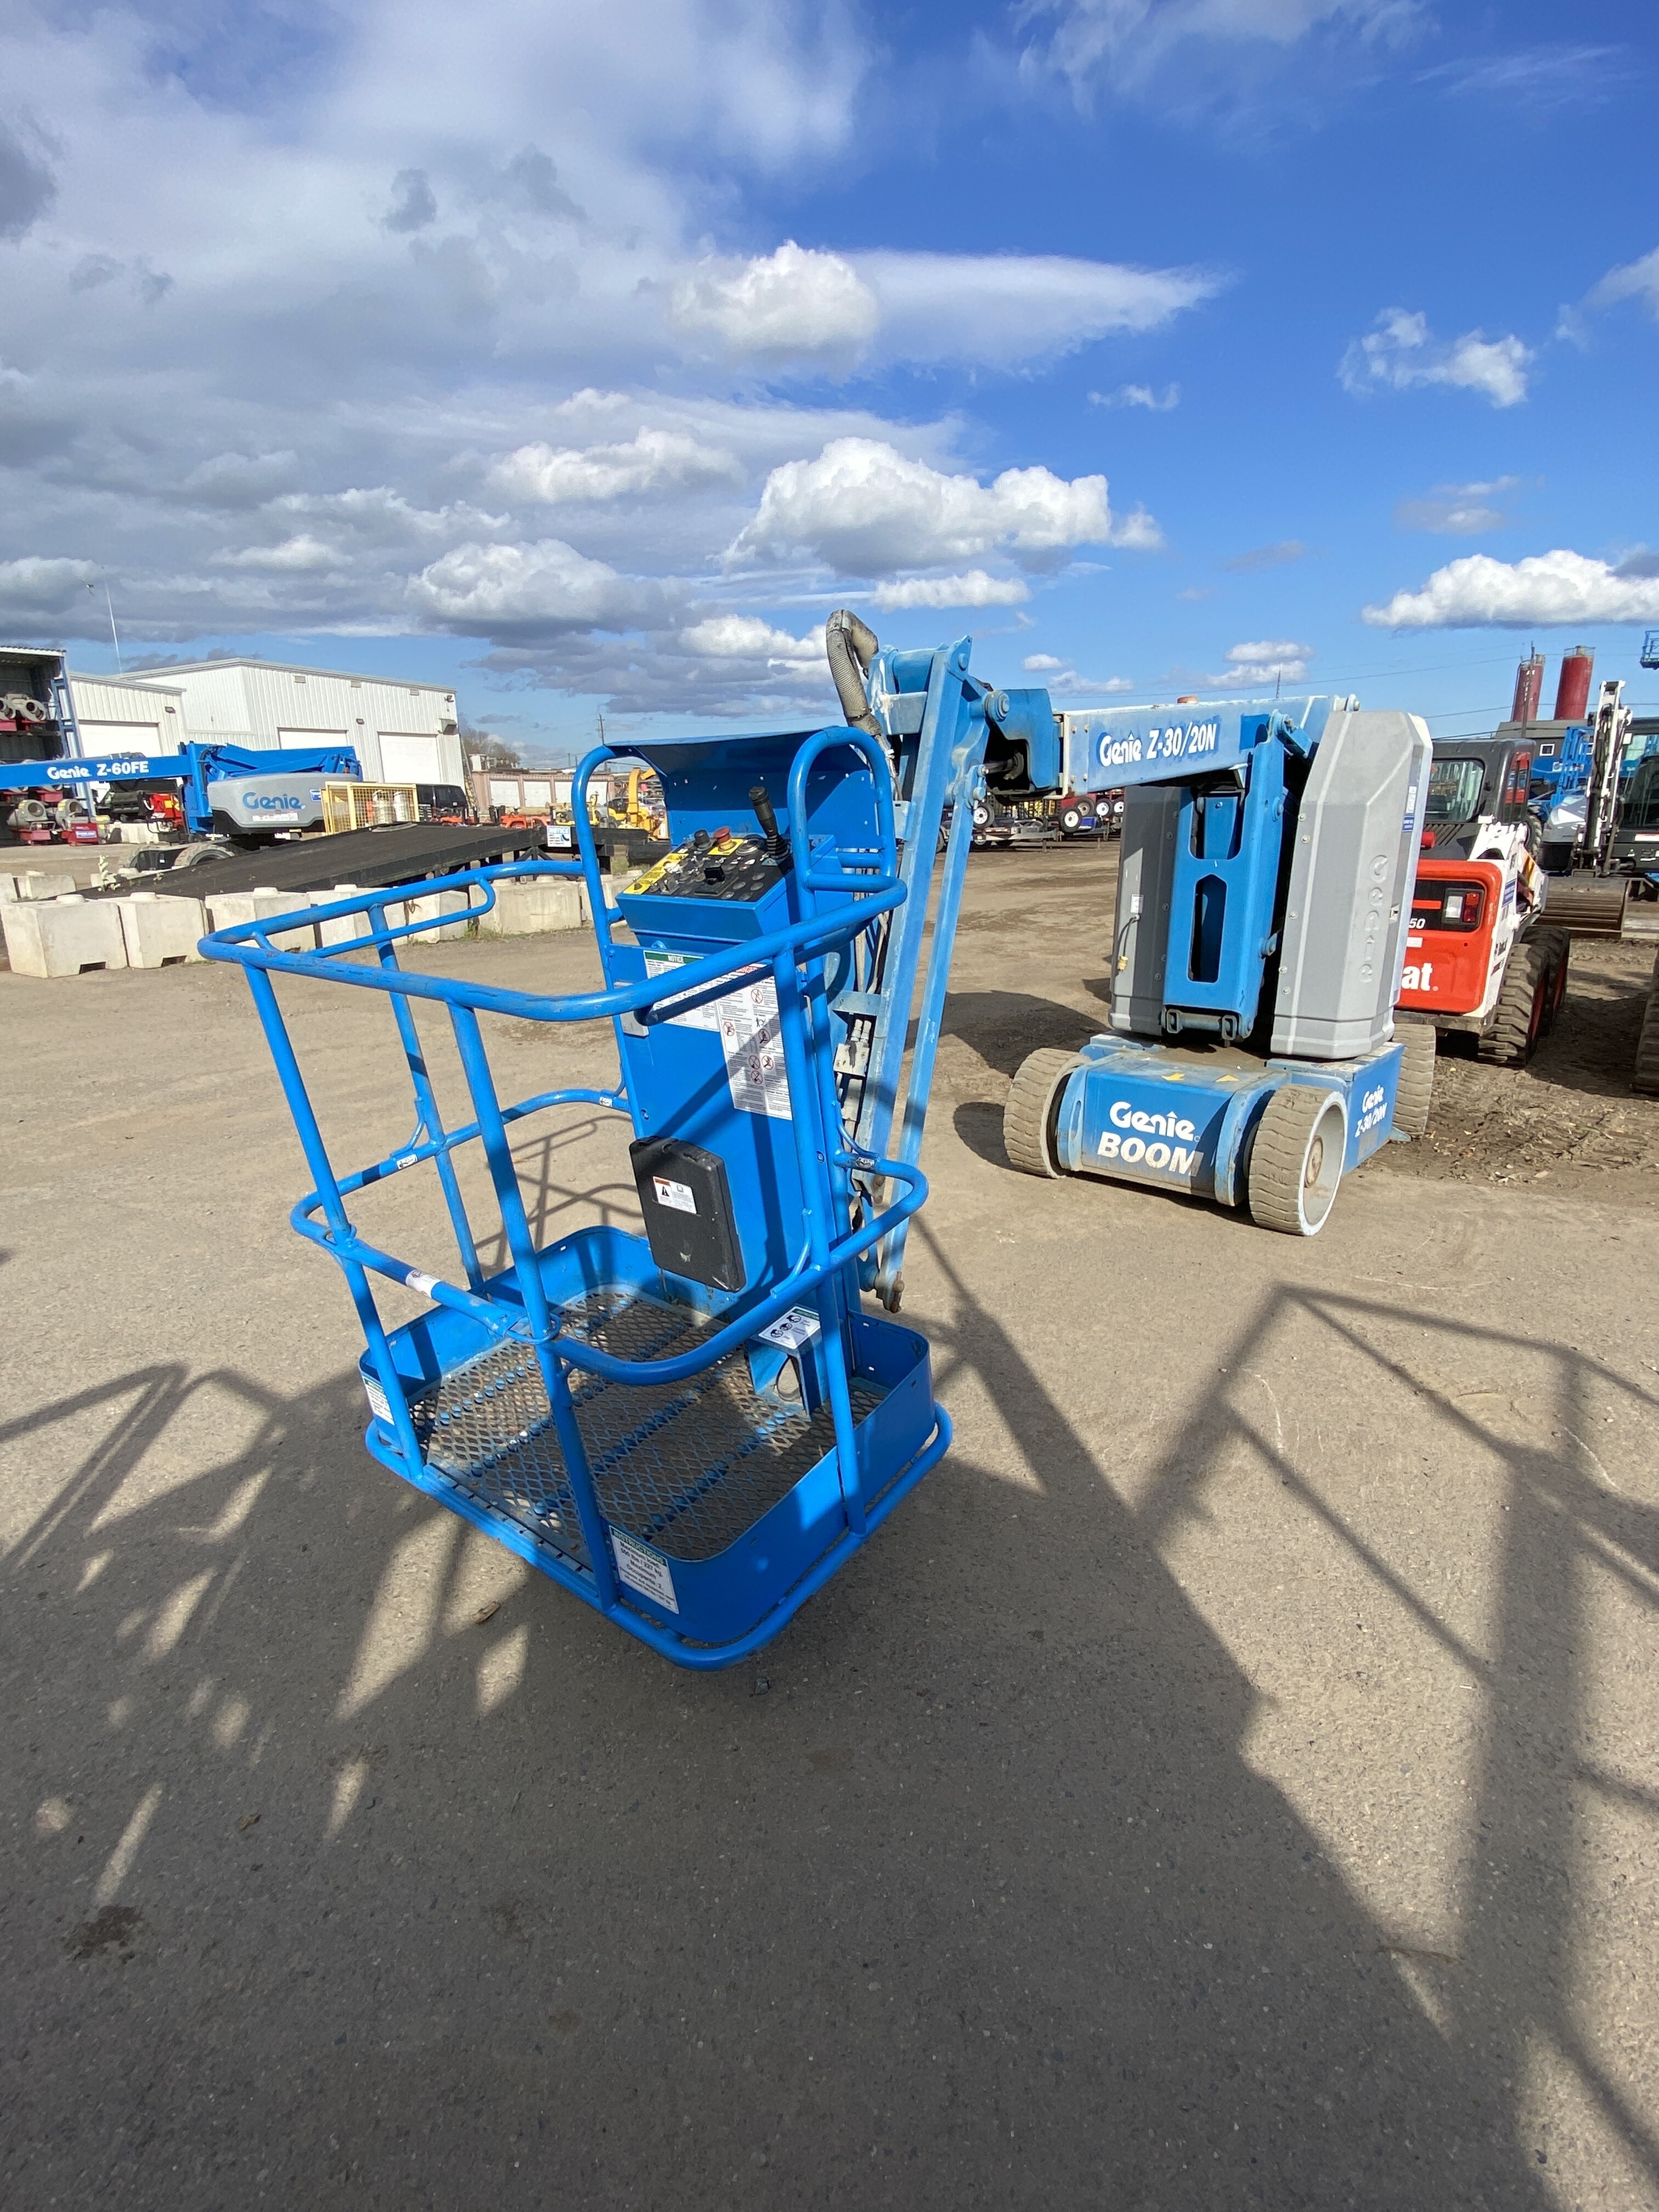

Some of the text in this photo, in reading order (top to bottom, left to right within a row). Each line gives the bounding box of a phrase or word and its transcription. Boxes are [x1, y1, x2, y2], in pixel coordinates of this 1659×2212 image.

[1099, 721, 1217, 767] Genie Z-30/20N
[47, 761, 149, 780] Genie Z-60FE
[242, 792, 302, 810] Genie
[1359, 855, 1388, 983] Genie
[1362, 1085, 1384, 1113] Genie
[1110, 1101, 1195, 1141] Genie
[1355, 1102, 1387, 1138] Z-30/20N
[1097, 1132, 1204, 1177] BOOM
[613, 1530, 664, 1564] INSTRUCTIONS
